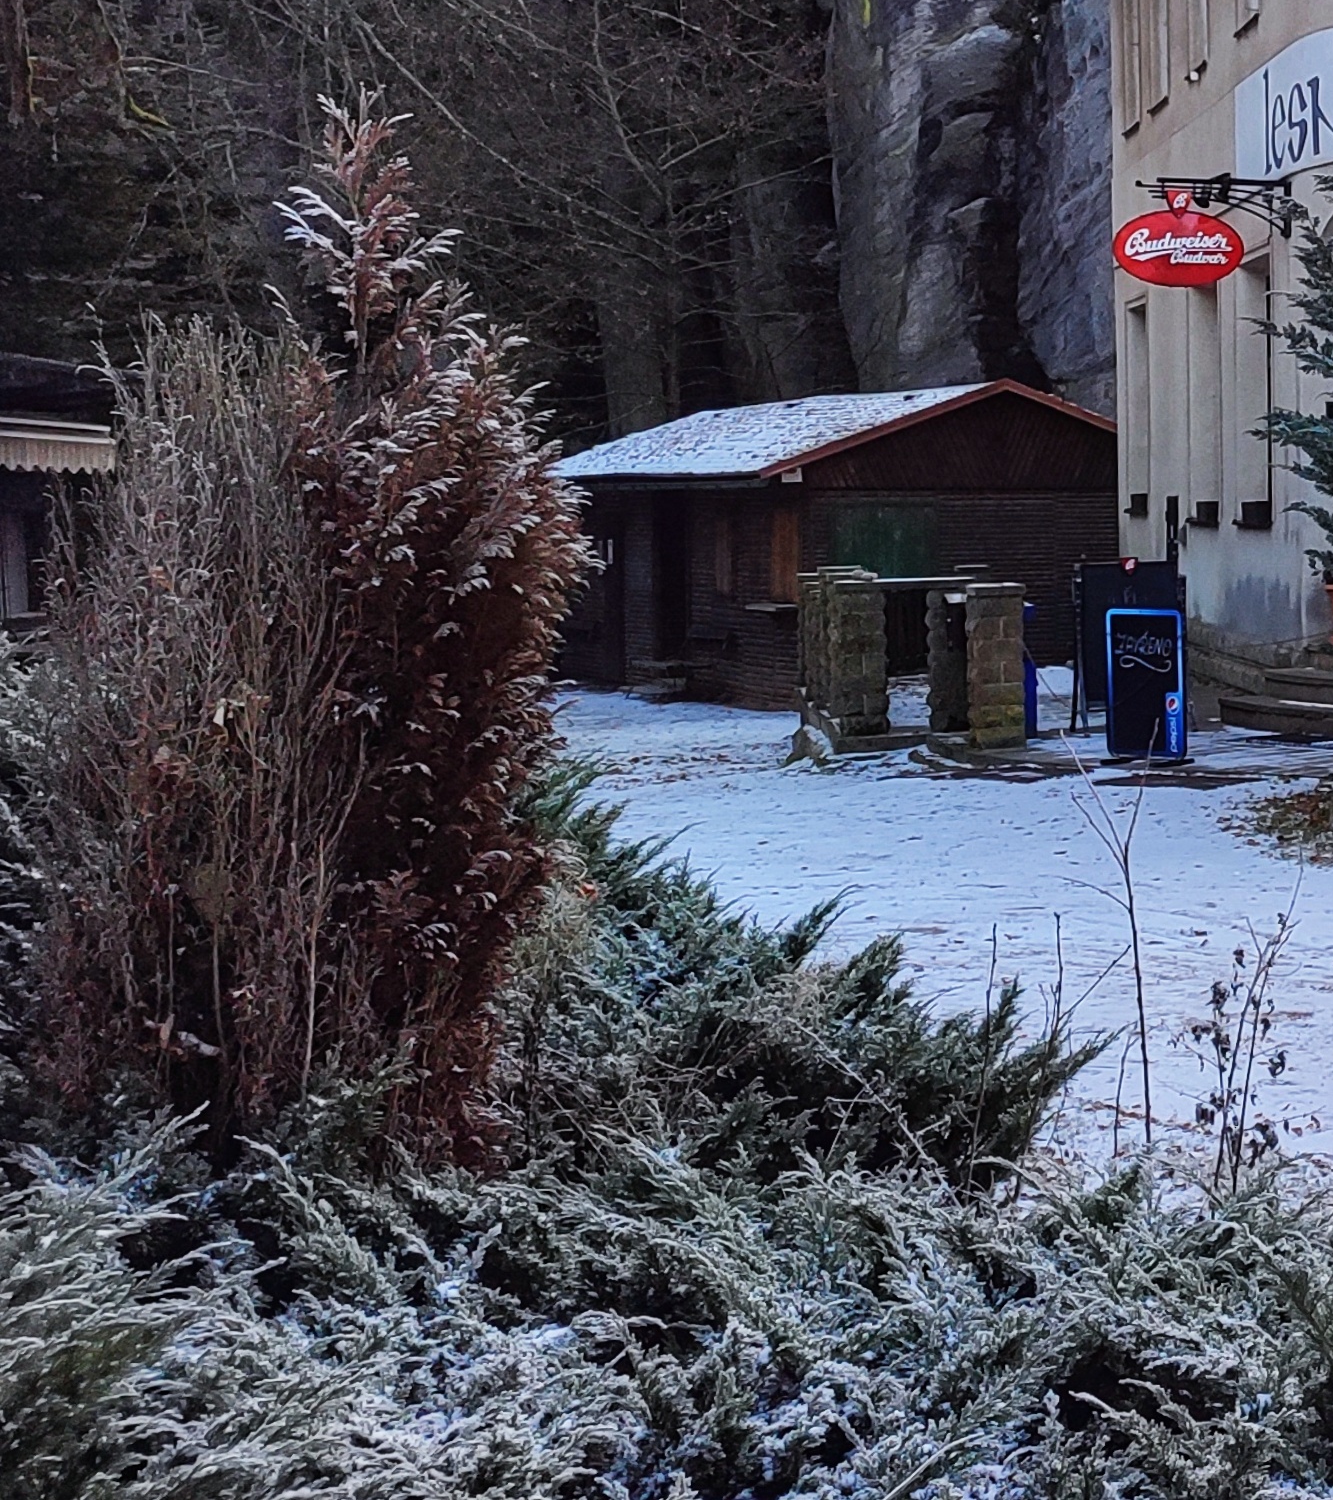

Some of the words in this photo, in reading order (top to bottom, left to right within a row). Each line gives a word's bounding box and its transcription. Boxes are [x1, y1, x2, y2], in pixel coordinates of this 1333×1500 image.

[1124, 228, 1231, 256] Budweiser
[1170, 248, 1229, 265] Budvar
[1168, 717, 1178, 753] pepsi
